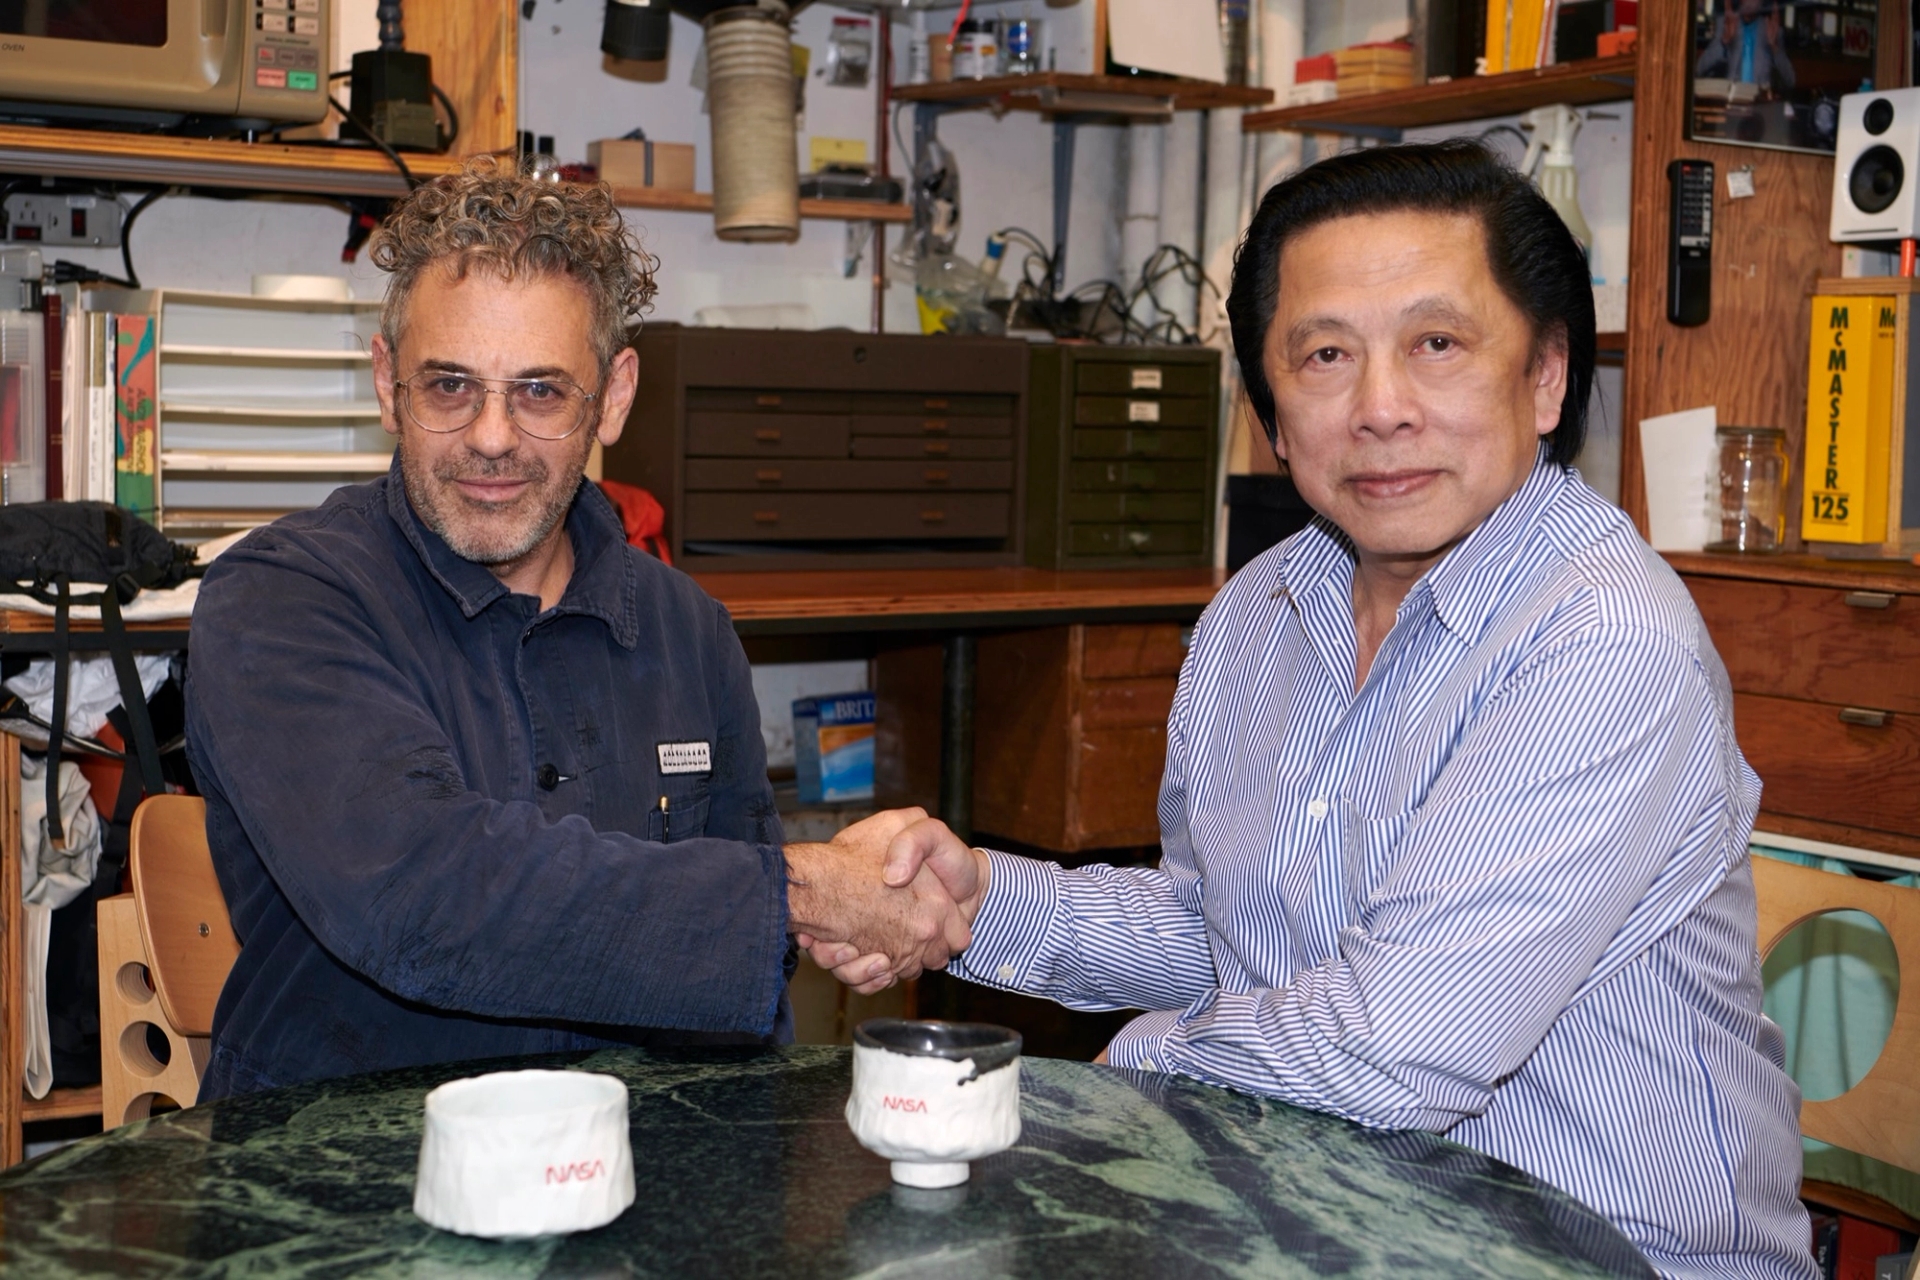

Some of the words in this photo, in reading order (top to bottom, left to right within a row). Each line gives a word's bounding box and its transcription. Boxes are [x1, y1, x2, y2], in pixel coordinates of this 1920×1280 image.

[1, 43, 25, 51] OVEN
[1812, 495, 1849, 521] 125
[835, 699, 876, 720] BRIT
[882, 1095, 928, 1114] NASA
[544, 1159, 606, 1185] NASA
